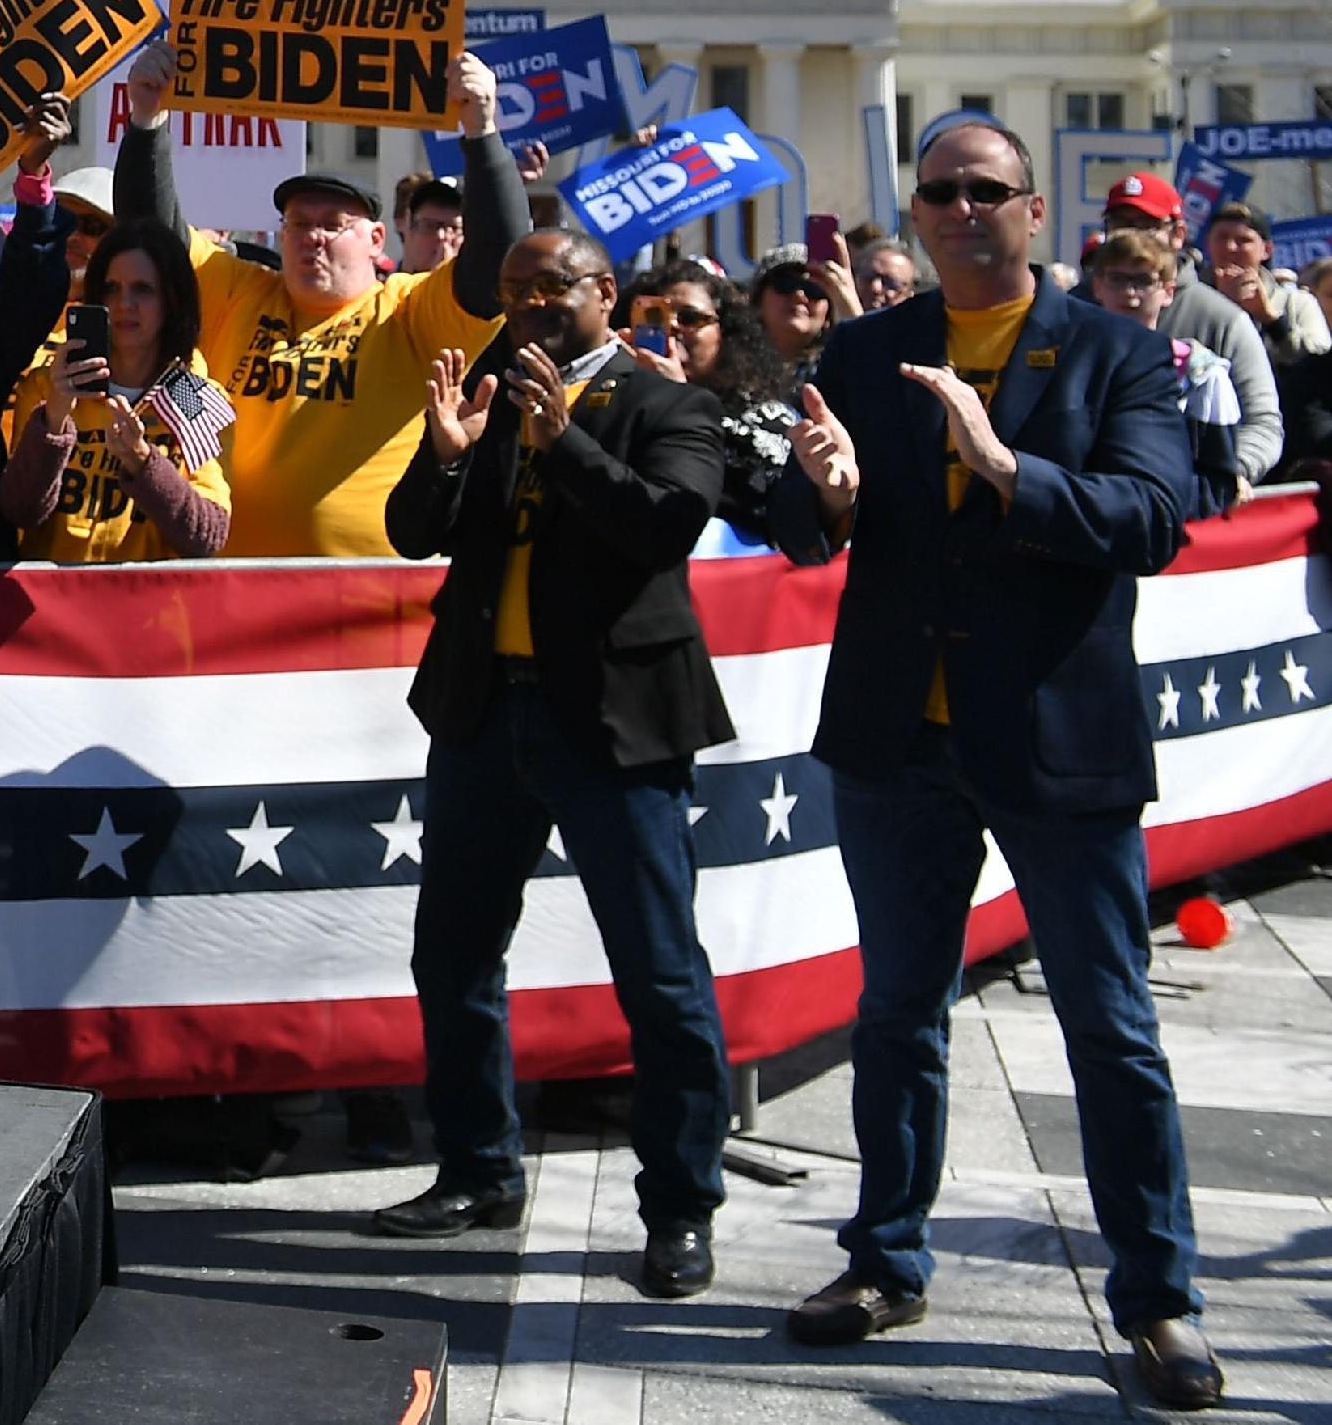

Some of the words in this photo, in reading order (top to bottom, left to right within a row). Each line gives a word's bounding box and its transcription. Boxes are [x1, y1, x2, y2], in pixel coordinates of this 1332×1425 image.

[174, 22, 198, 97] FOR
[204, 27, 450, 115] BIDEN
[495, 58, 608, 131] DEN
[518, 52, 559, 75] FOR
[658, 131, 698, 157] FOR
[584, 132, 760, 235] BIDEN
[57, 468, 129, 520] BID
